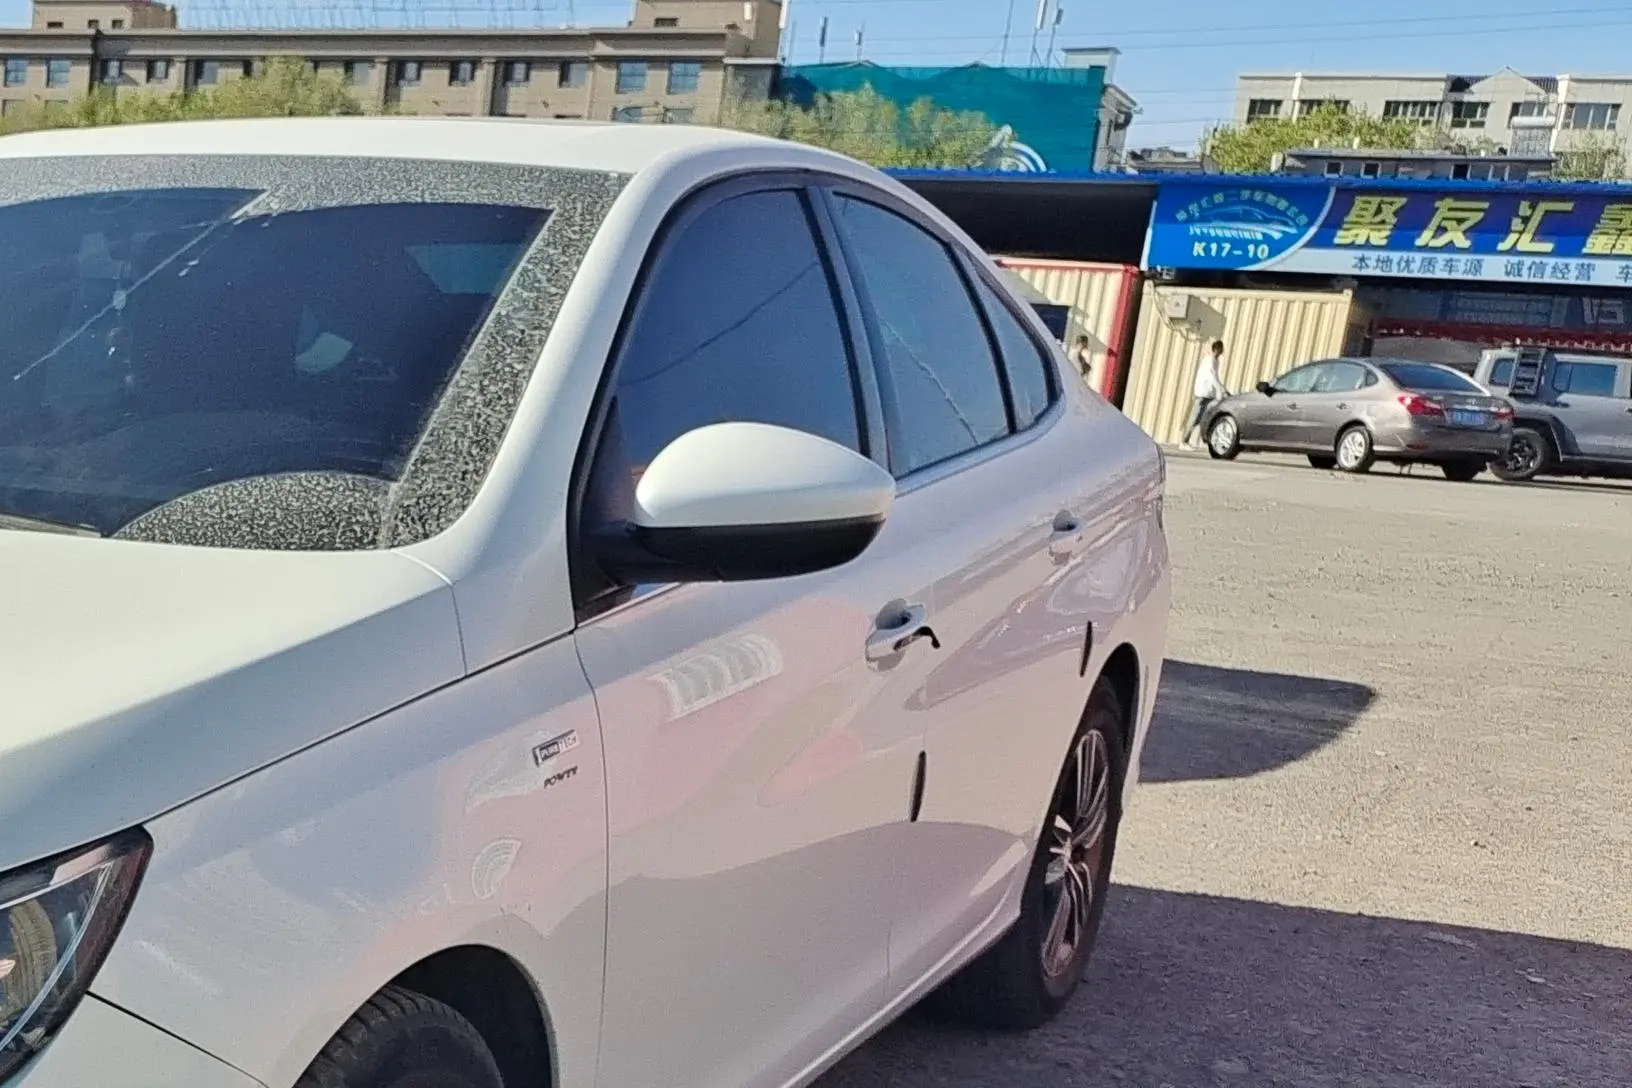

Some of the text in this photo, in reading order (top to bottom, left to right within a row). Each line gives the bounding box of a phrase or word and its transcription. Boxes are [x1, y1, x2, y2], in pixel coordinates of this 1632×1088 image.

[1192, 240, 1270, 260] K17-10
[1351, 254, 1485, 277] 本地优质车源
[1503, 258, 1597, 282] 诚信经营
